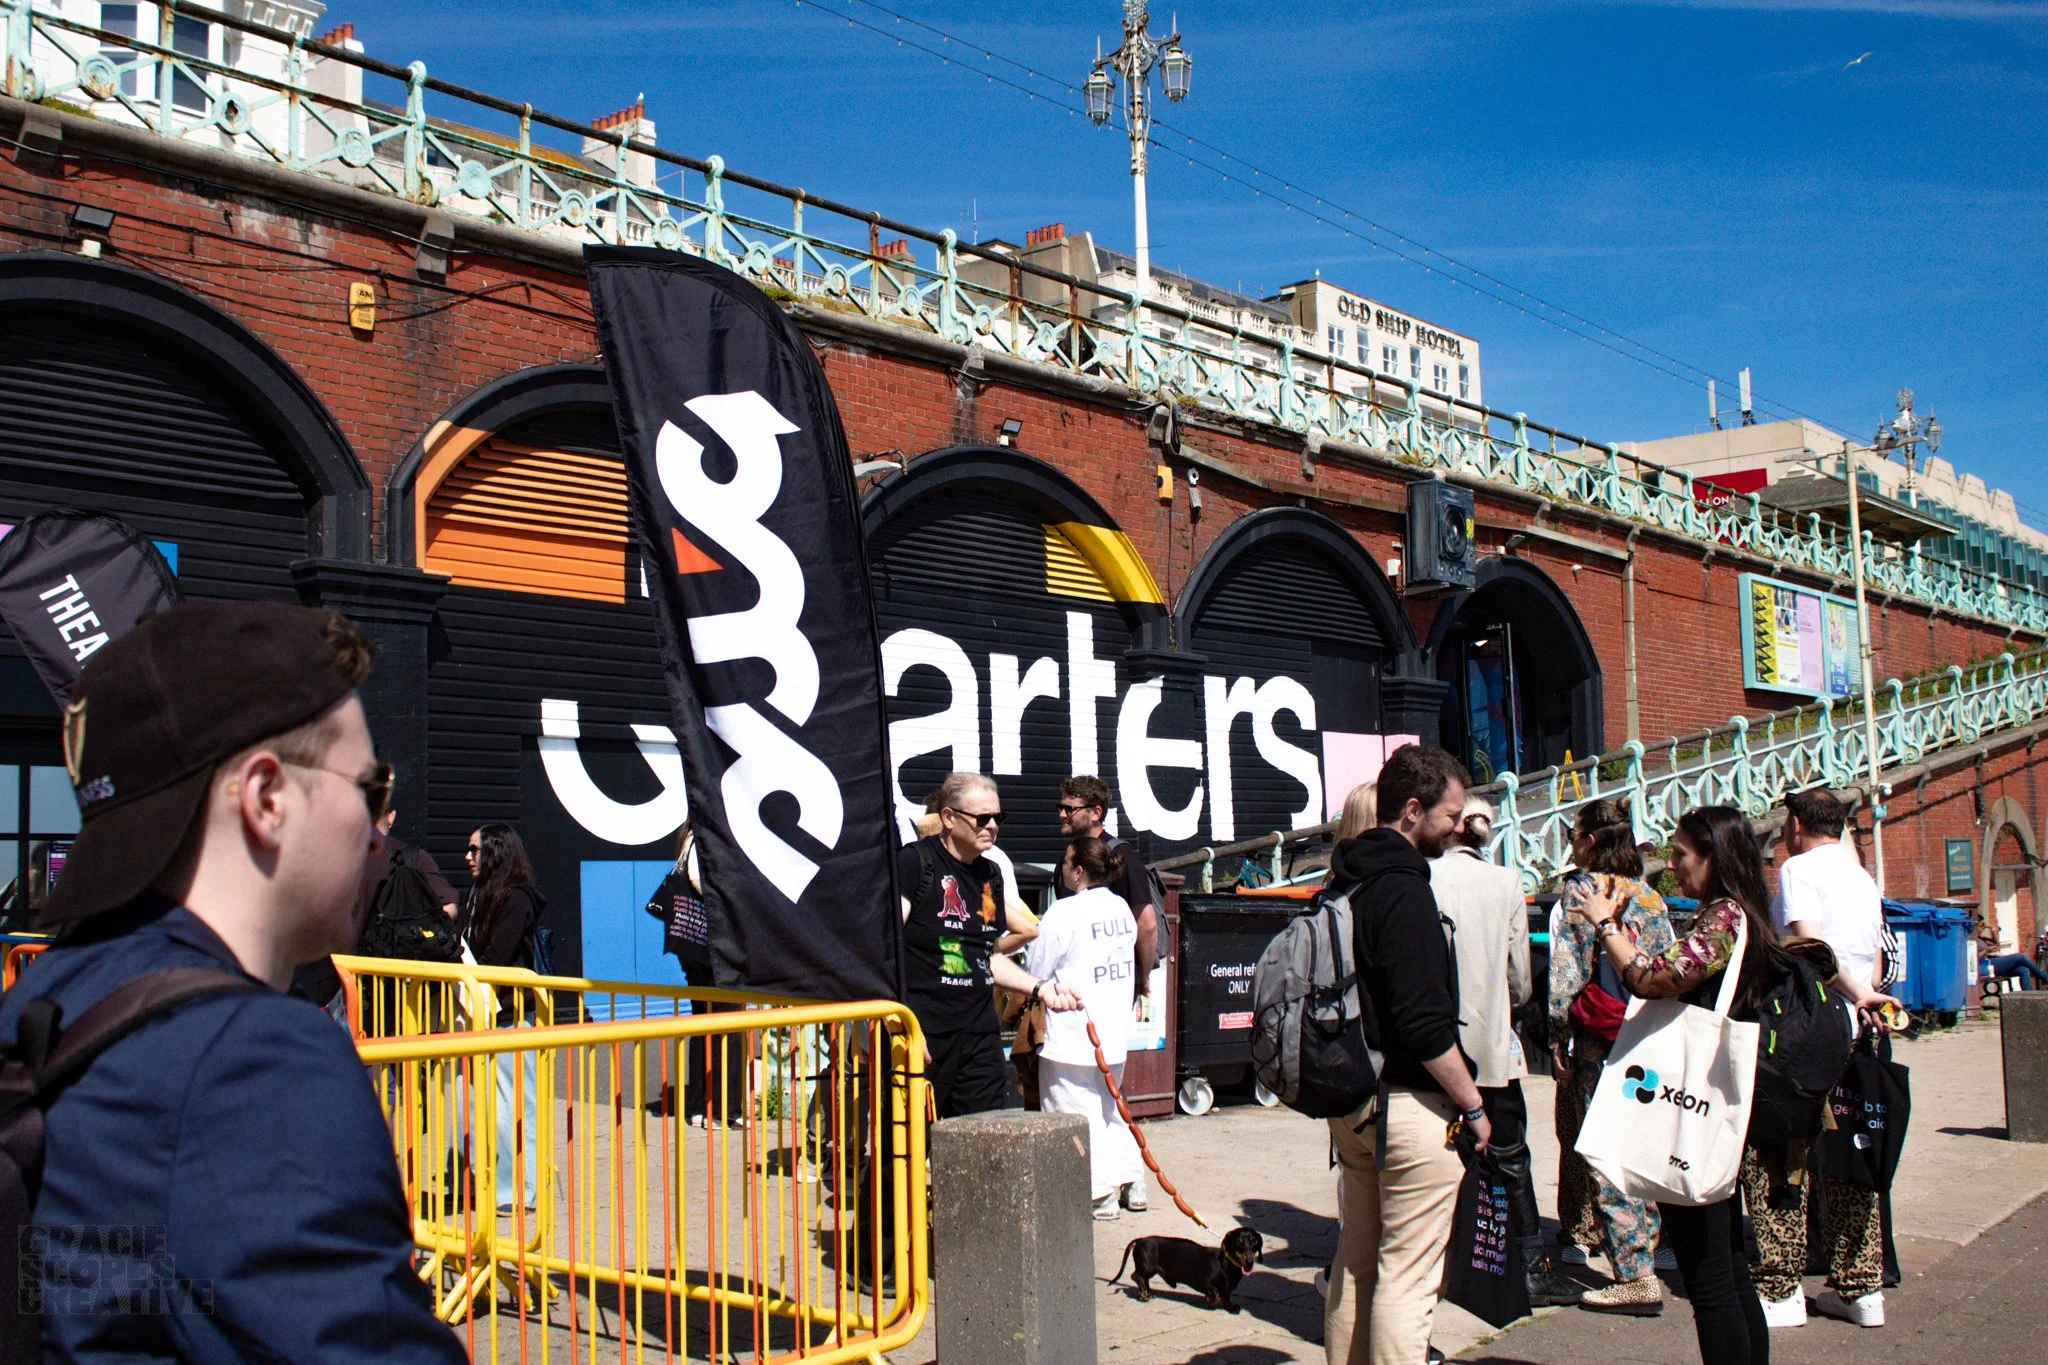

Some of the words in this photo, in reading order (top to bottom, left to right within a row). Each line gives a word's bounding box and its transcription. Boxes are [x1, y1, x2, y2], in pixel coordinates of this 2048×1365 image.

[1338, 295, 1371, 323] OLD
[1376, 309, 1410, 338] SHIP
[1416, 323, 1464, 358] HOTEL
[39, 574, 109, 669] THEA
[944, 920, 964, 930] WAR
[1091, 918, 1132, 939] FULL
[1094, 960, 1132, 983] PELT
[1210, 963, 1242, 977] General
[941, 976, 973, 987] PLAGUE
[1228, 980, 1250, 994] ONLY
